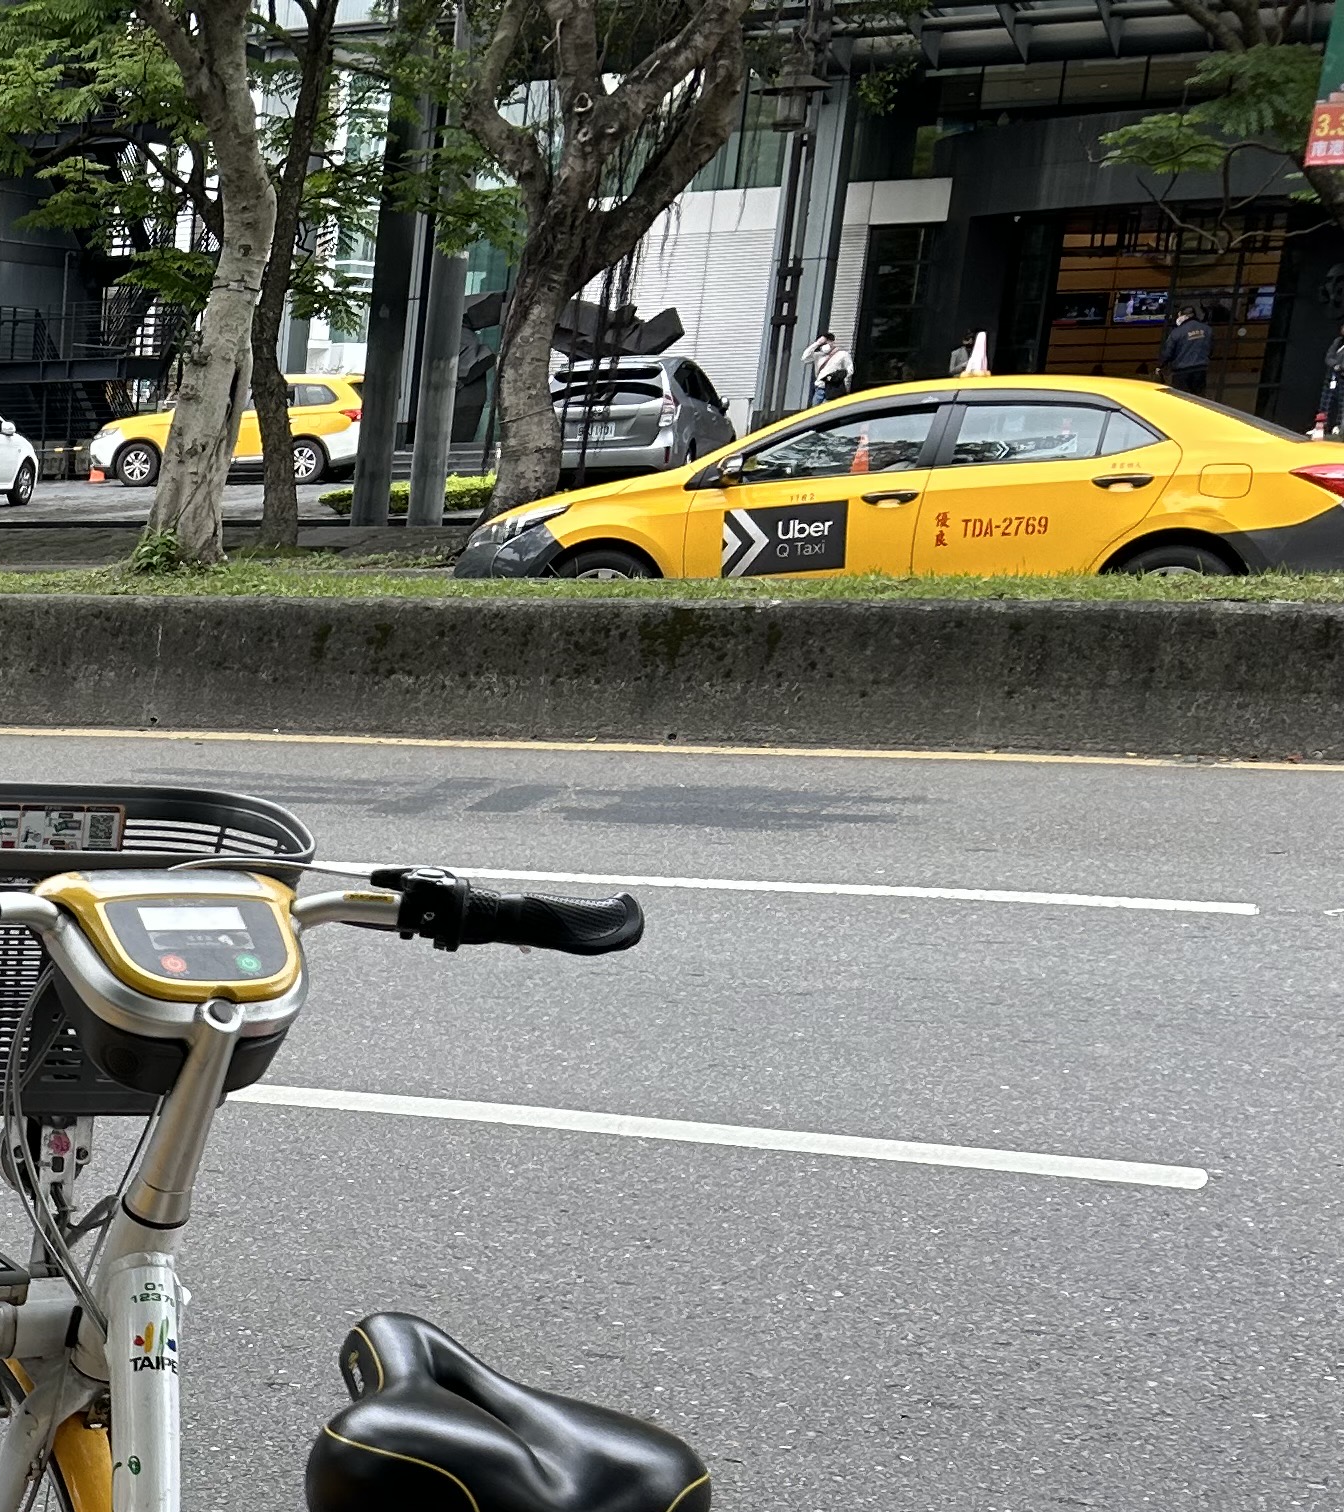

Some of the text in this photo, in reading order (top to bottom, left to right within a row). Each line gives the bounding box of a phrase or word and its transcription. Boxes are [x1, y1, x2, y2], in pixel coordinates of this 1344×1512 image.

[777, 519, 833, 540] Uber
[934, 511, 951, 548] 優良
[961, 516, 1049, 539] TDA-2769
[776, 540, 826, 558] Q Taxi
